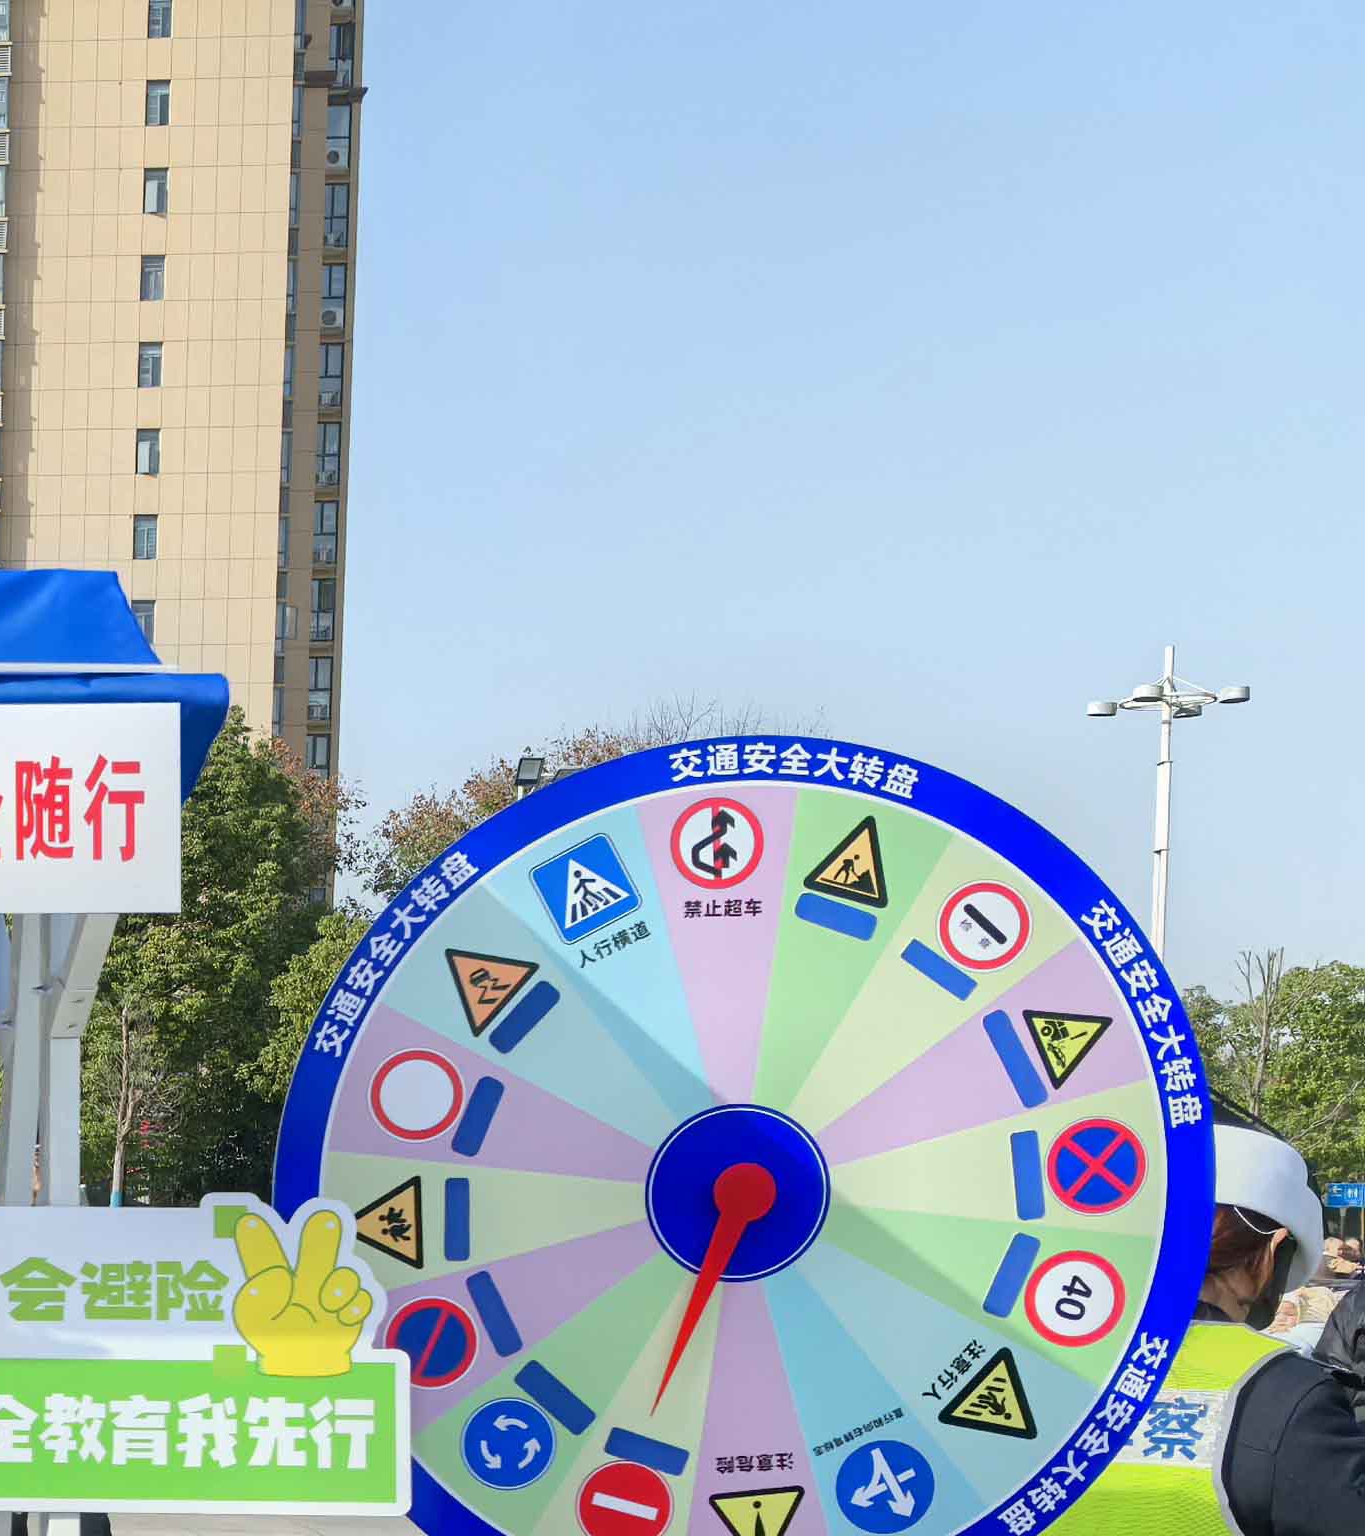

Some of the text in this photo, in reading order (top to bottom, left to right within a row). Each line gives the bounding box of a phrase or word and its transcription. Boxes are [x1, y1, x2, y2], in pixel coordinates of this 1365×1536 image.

[668, 741, 920, 799] 交通安全大转盘
[684, 898, 762, 919] 禁止超车
[314, 851, 479, 1058] 交通安全大转盘
[579, 920, 651, 968] 人行横道
[1080, 900, 1203, 1128] 交通安全大转盘
[0, 1256, 230, 1322] 会避险
[1053, 1275, 1093, 1321] 40
[922, 1339, 986, 1401] 注意行人
[716, 1452, 794, 1475] 注意危险
